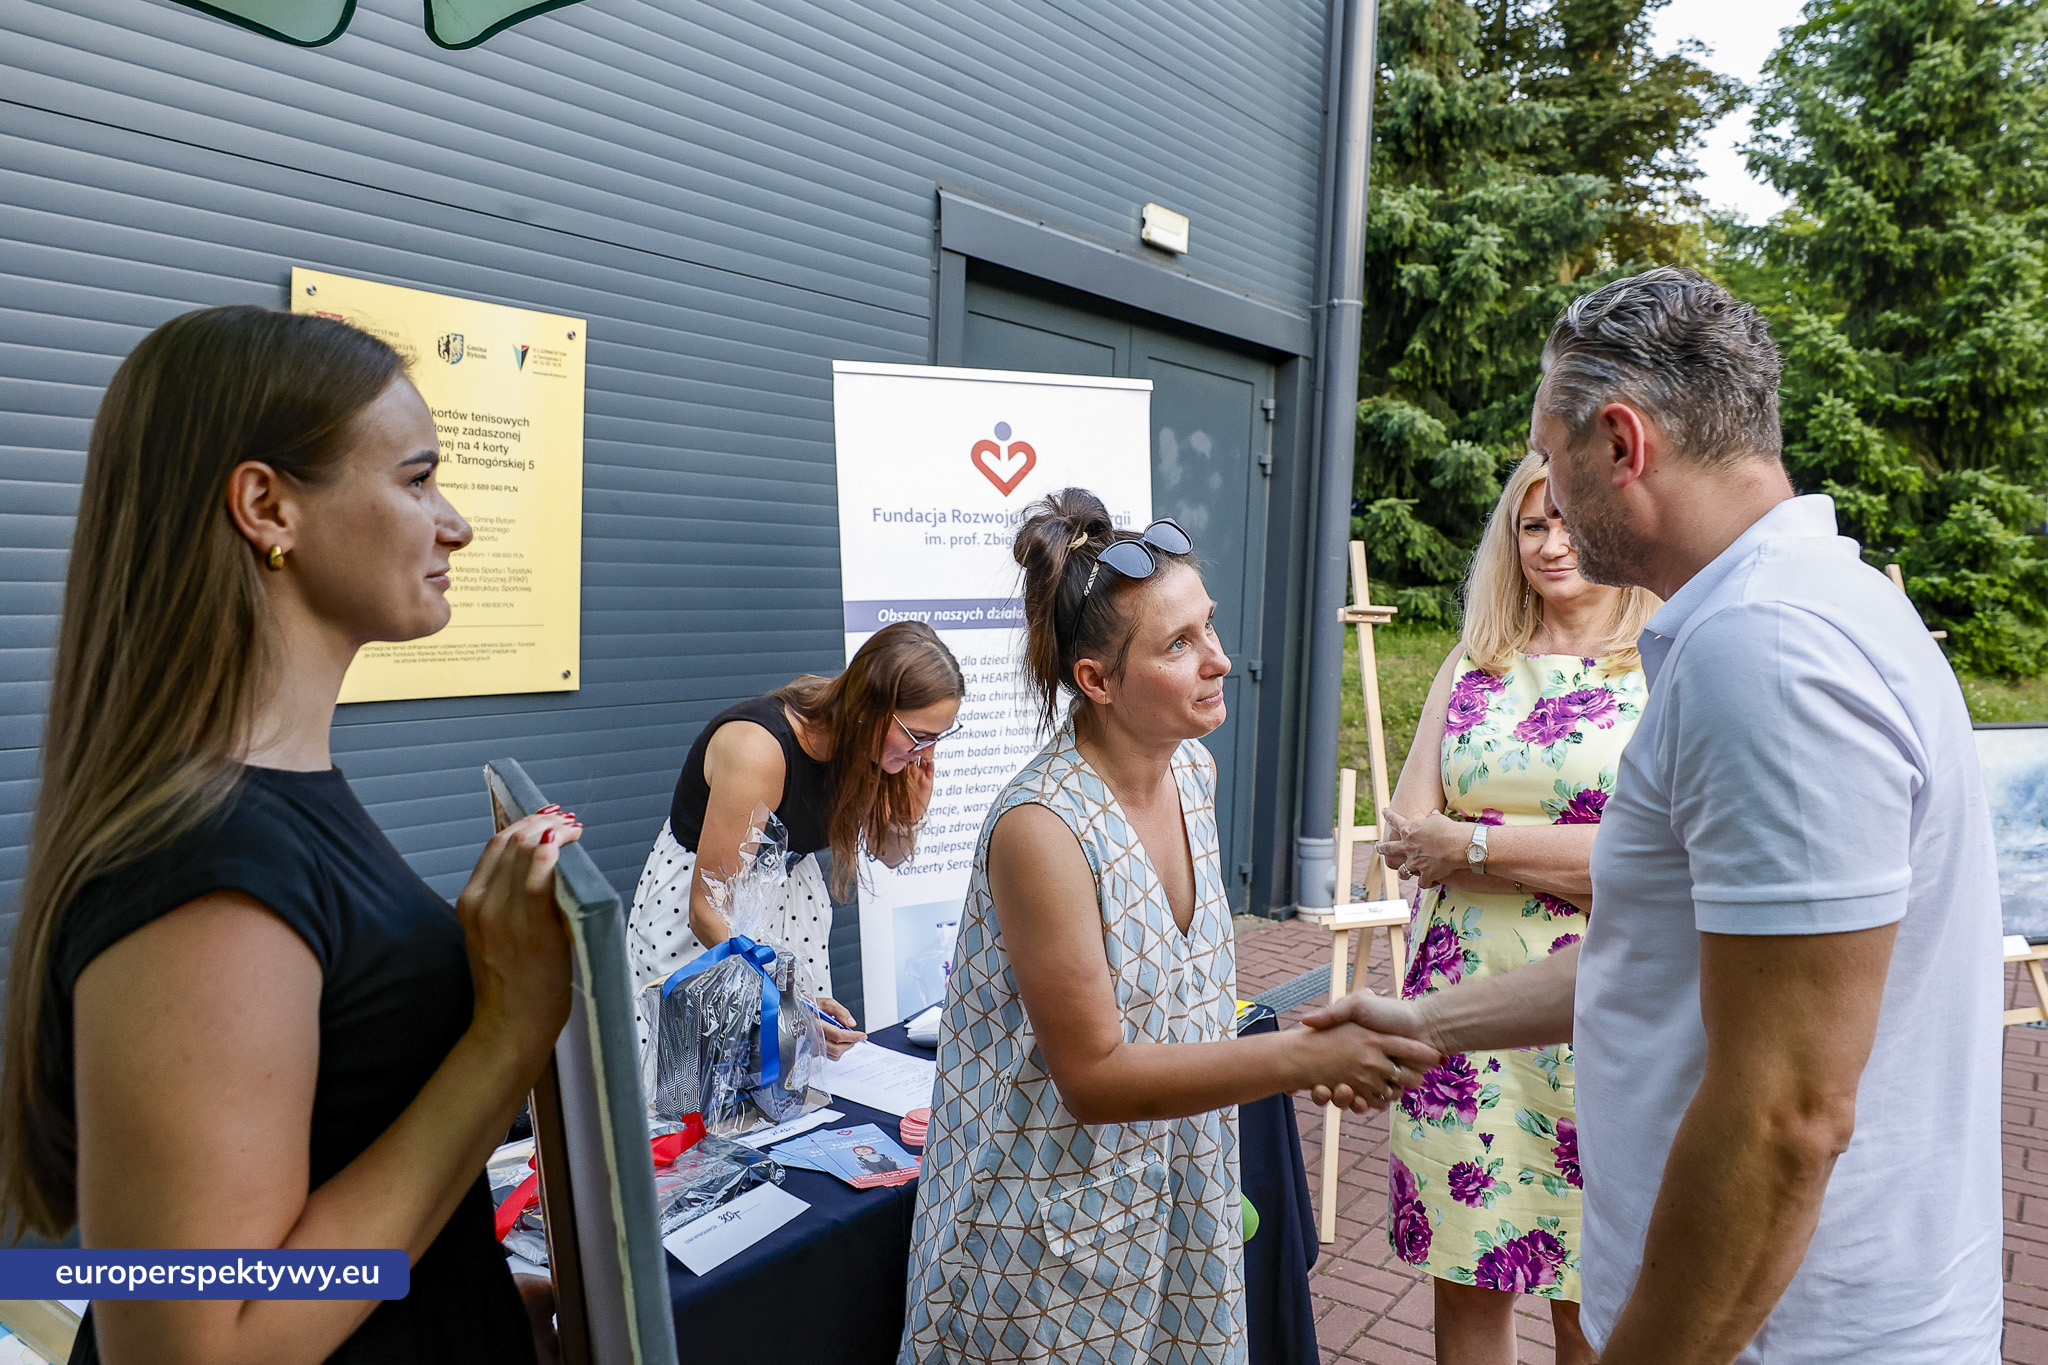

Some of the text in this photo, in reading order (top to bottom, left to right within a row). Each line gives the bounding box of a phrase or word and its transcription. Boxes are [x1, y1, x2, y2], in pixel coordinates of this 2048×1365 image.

[466, 344, 488, 353] Gmina
[466, 351, 488, 361] Bytom
[431, 407, 530, 428] kortów tenisowych
[462, 427, 521, 443] zadaszonej
[457, 441, 470, 450] na
[473, 441, 480, 450] 4
[483, 442, 509, 456] korty
[440, 453, 535, 471] ul. Tarnogórskiej 5
[504, 485, 518, 493] PLN
[872, 507, 1017, 529] Fundacja Rozwoju
[925, 532, 1016, 550] im. prof. Zbig
[877, 607, 931, 623] Obszary
[933, 606, 984, 624] naszych
[960, 655, 977, 667] dla
[979, 654, 1009, 666] dzieci
[967, 746, 1001, 758] badań
[953, 762, 1017, 778] medycznych
[945, 786, 962, 797] dla
[965, 783, 1002, 798] lekarzy
[924, 838, 976, 856] najlepszej
[896, 860, 944, 876] Koncerty
